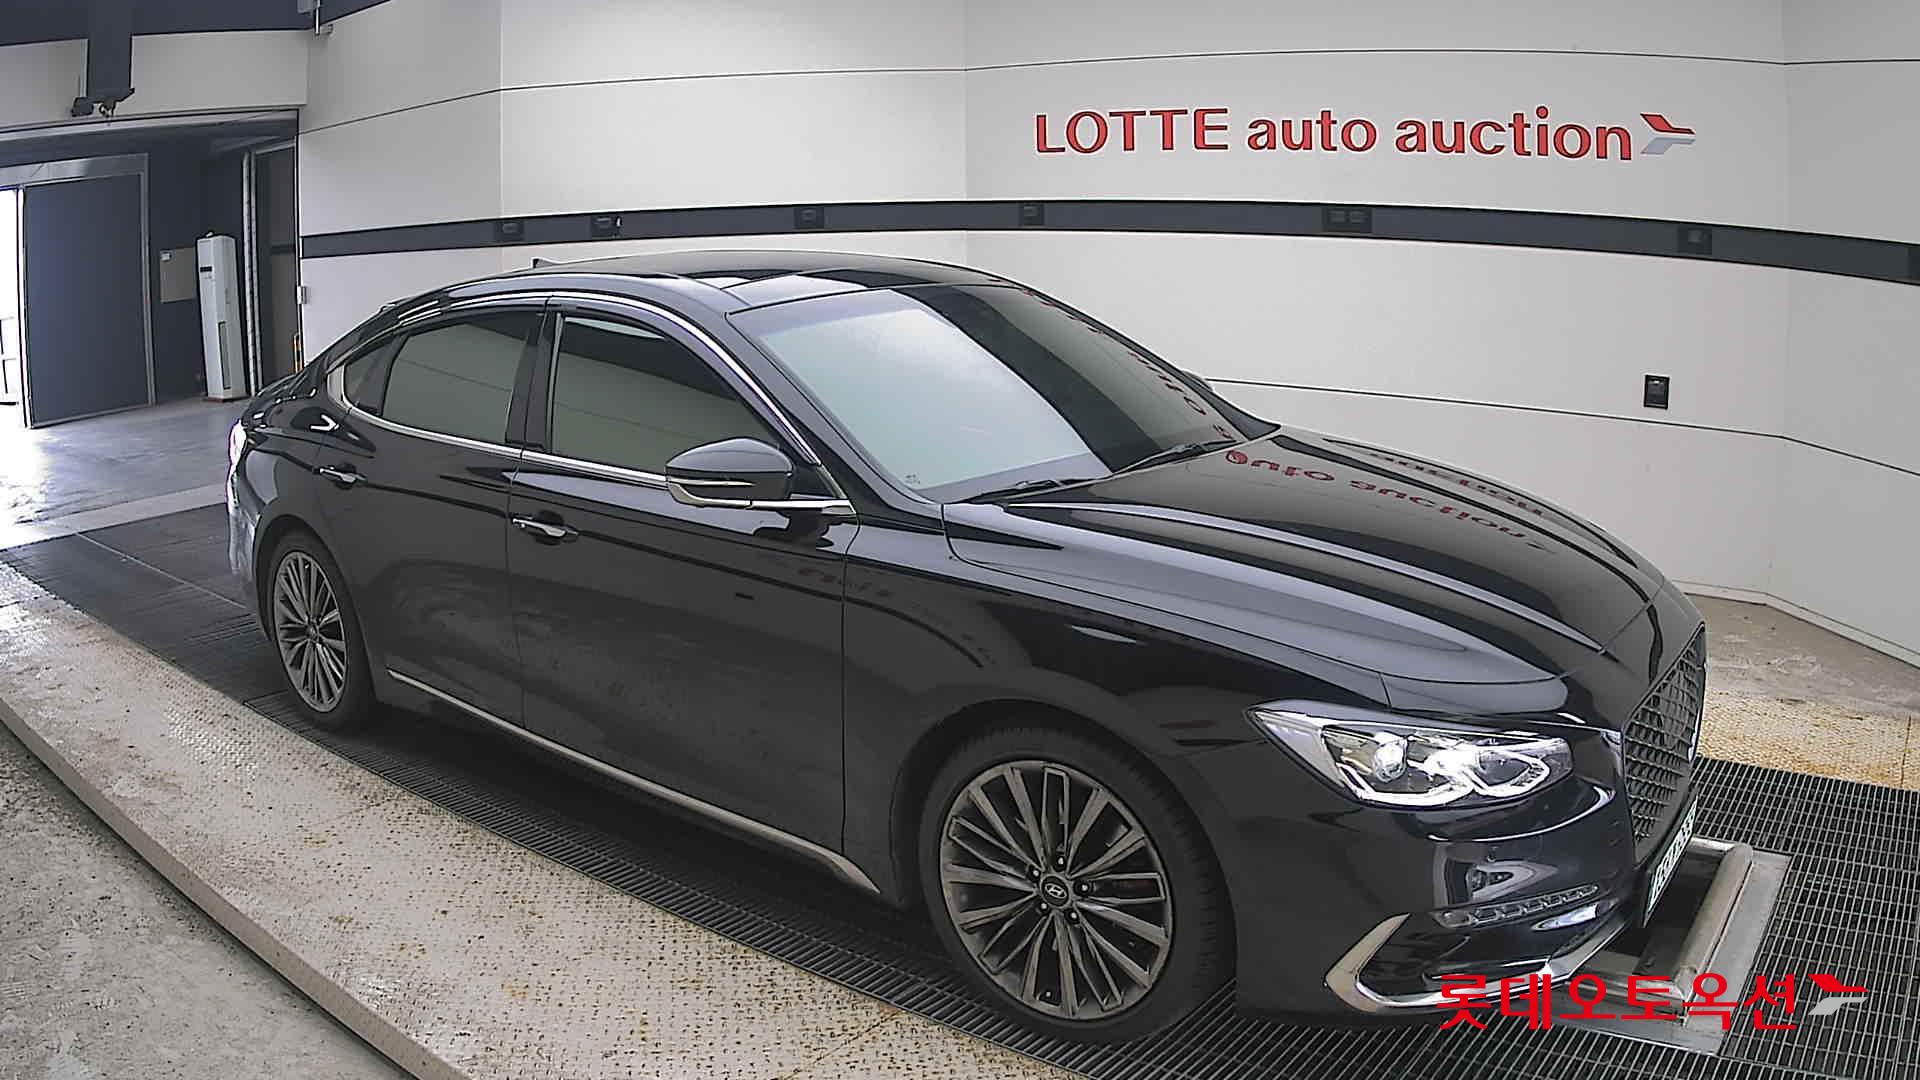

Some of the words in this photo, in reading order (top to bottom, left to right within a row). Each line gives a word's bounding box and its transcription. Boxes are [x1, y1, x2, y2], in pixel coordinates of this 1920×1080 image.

[1035, 107, 1229, 154] LOTTE
[1246, 109, 1378, 152] auto
[1395, 105, 1633, 161] auction
